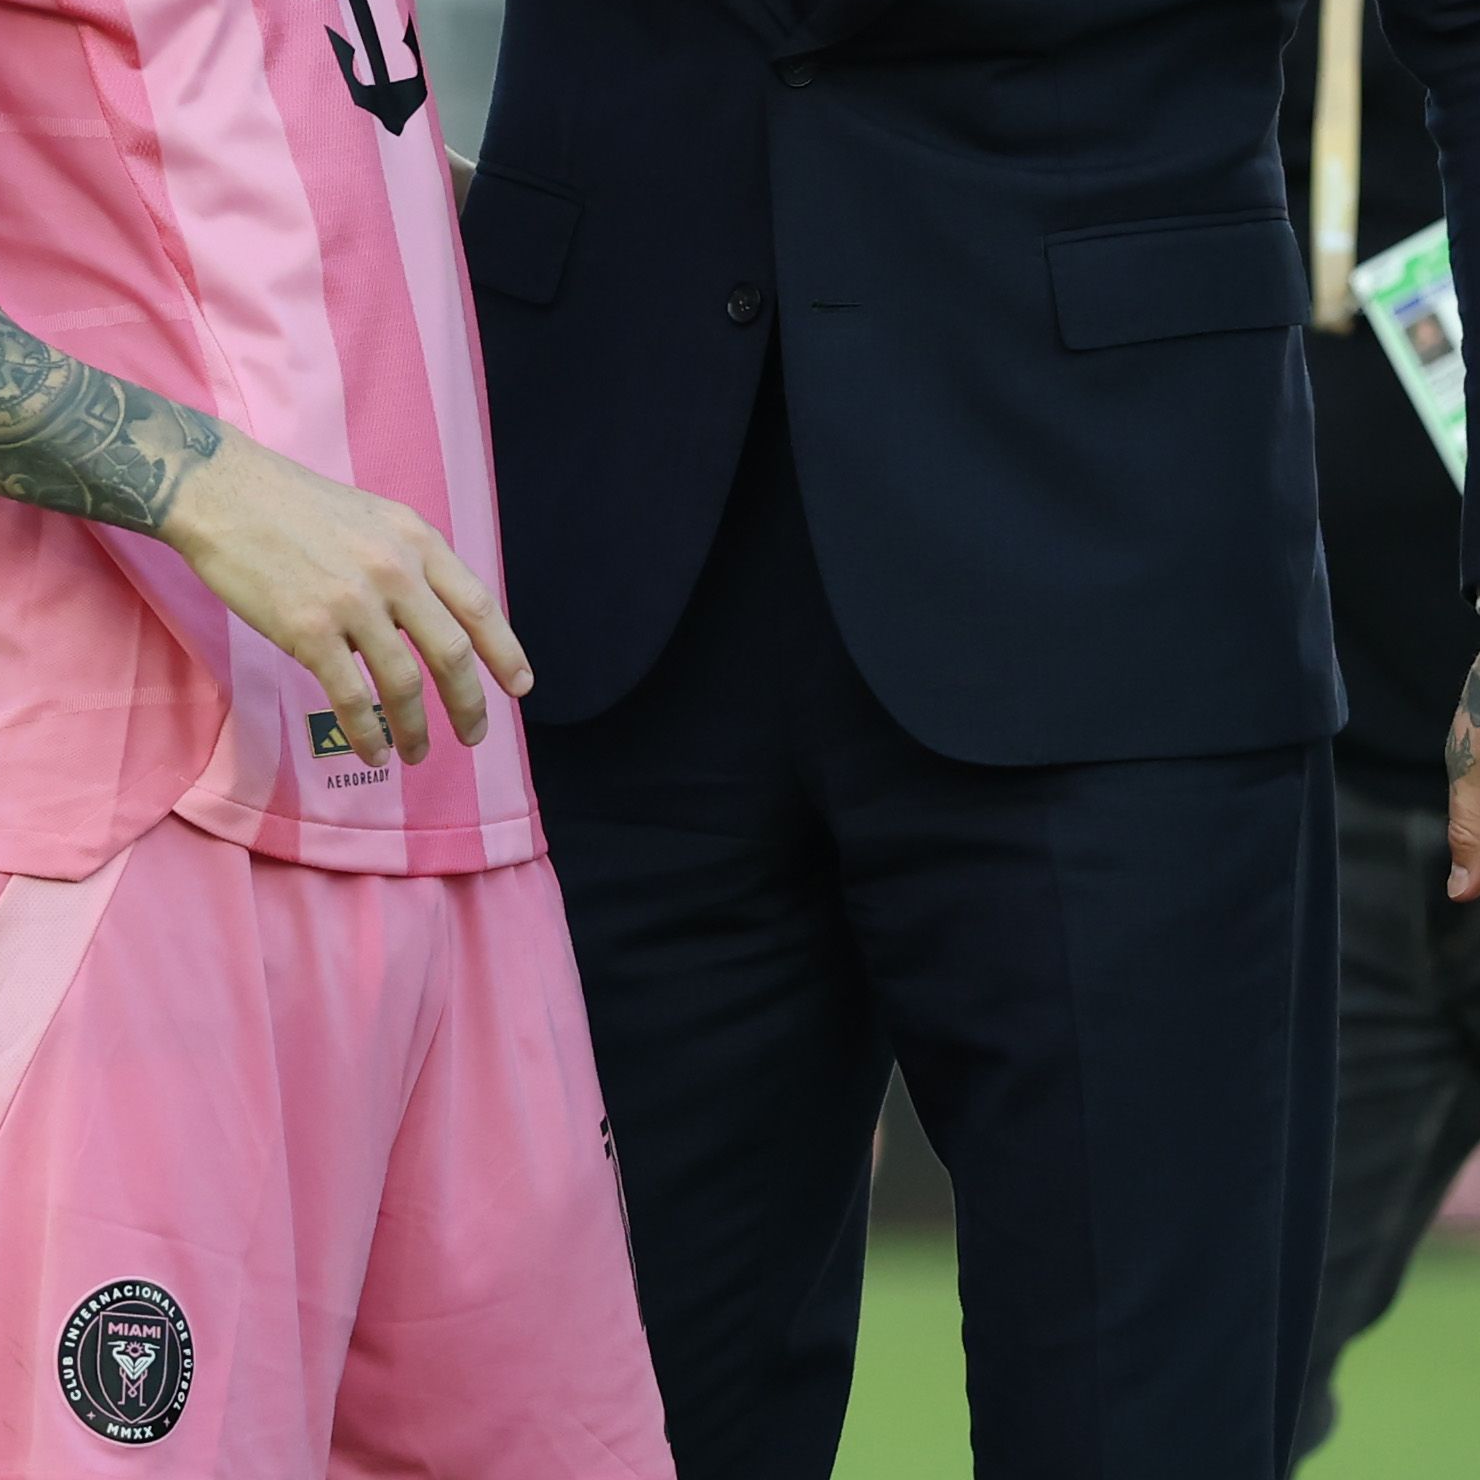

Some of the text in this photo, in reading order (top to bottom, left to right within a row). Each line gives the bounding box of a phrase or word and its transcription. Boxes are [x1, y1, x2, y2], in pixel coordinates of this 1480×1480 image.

[326, 768, 390, 790] AEROREADY
[65, 1285, 175, 1348] INTERNACIONAL
[107, 1321, 162, 1339] MIAMI
[175, 1320, 189, 1341] DE
[62, 1356, 82, 1401] CLUB
[106, 1422, 154, 1440] MMXX
